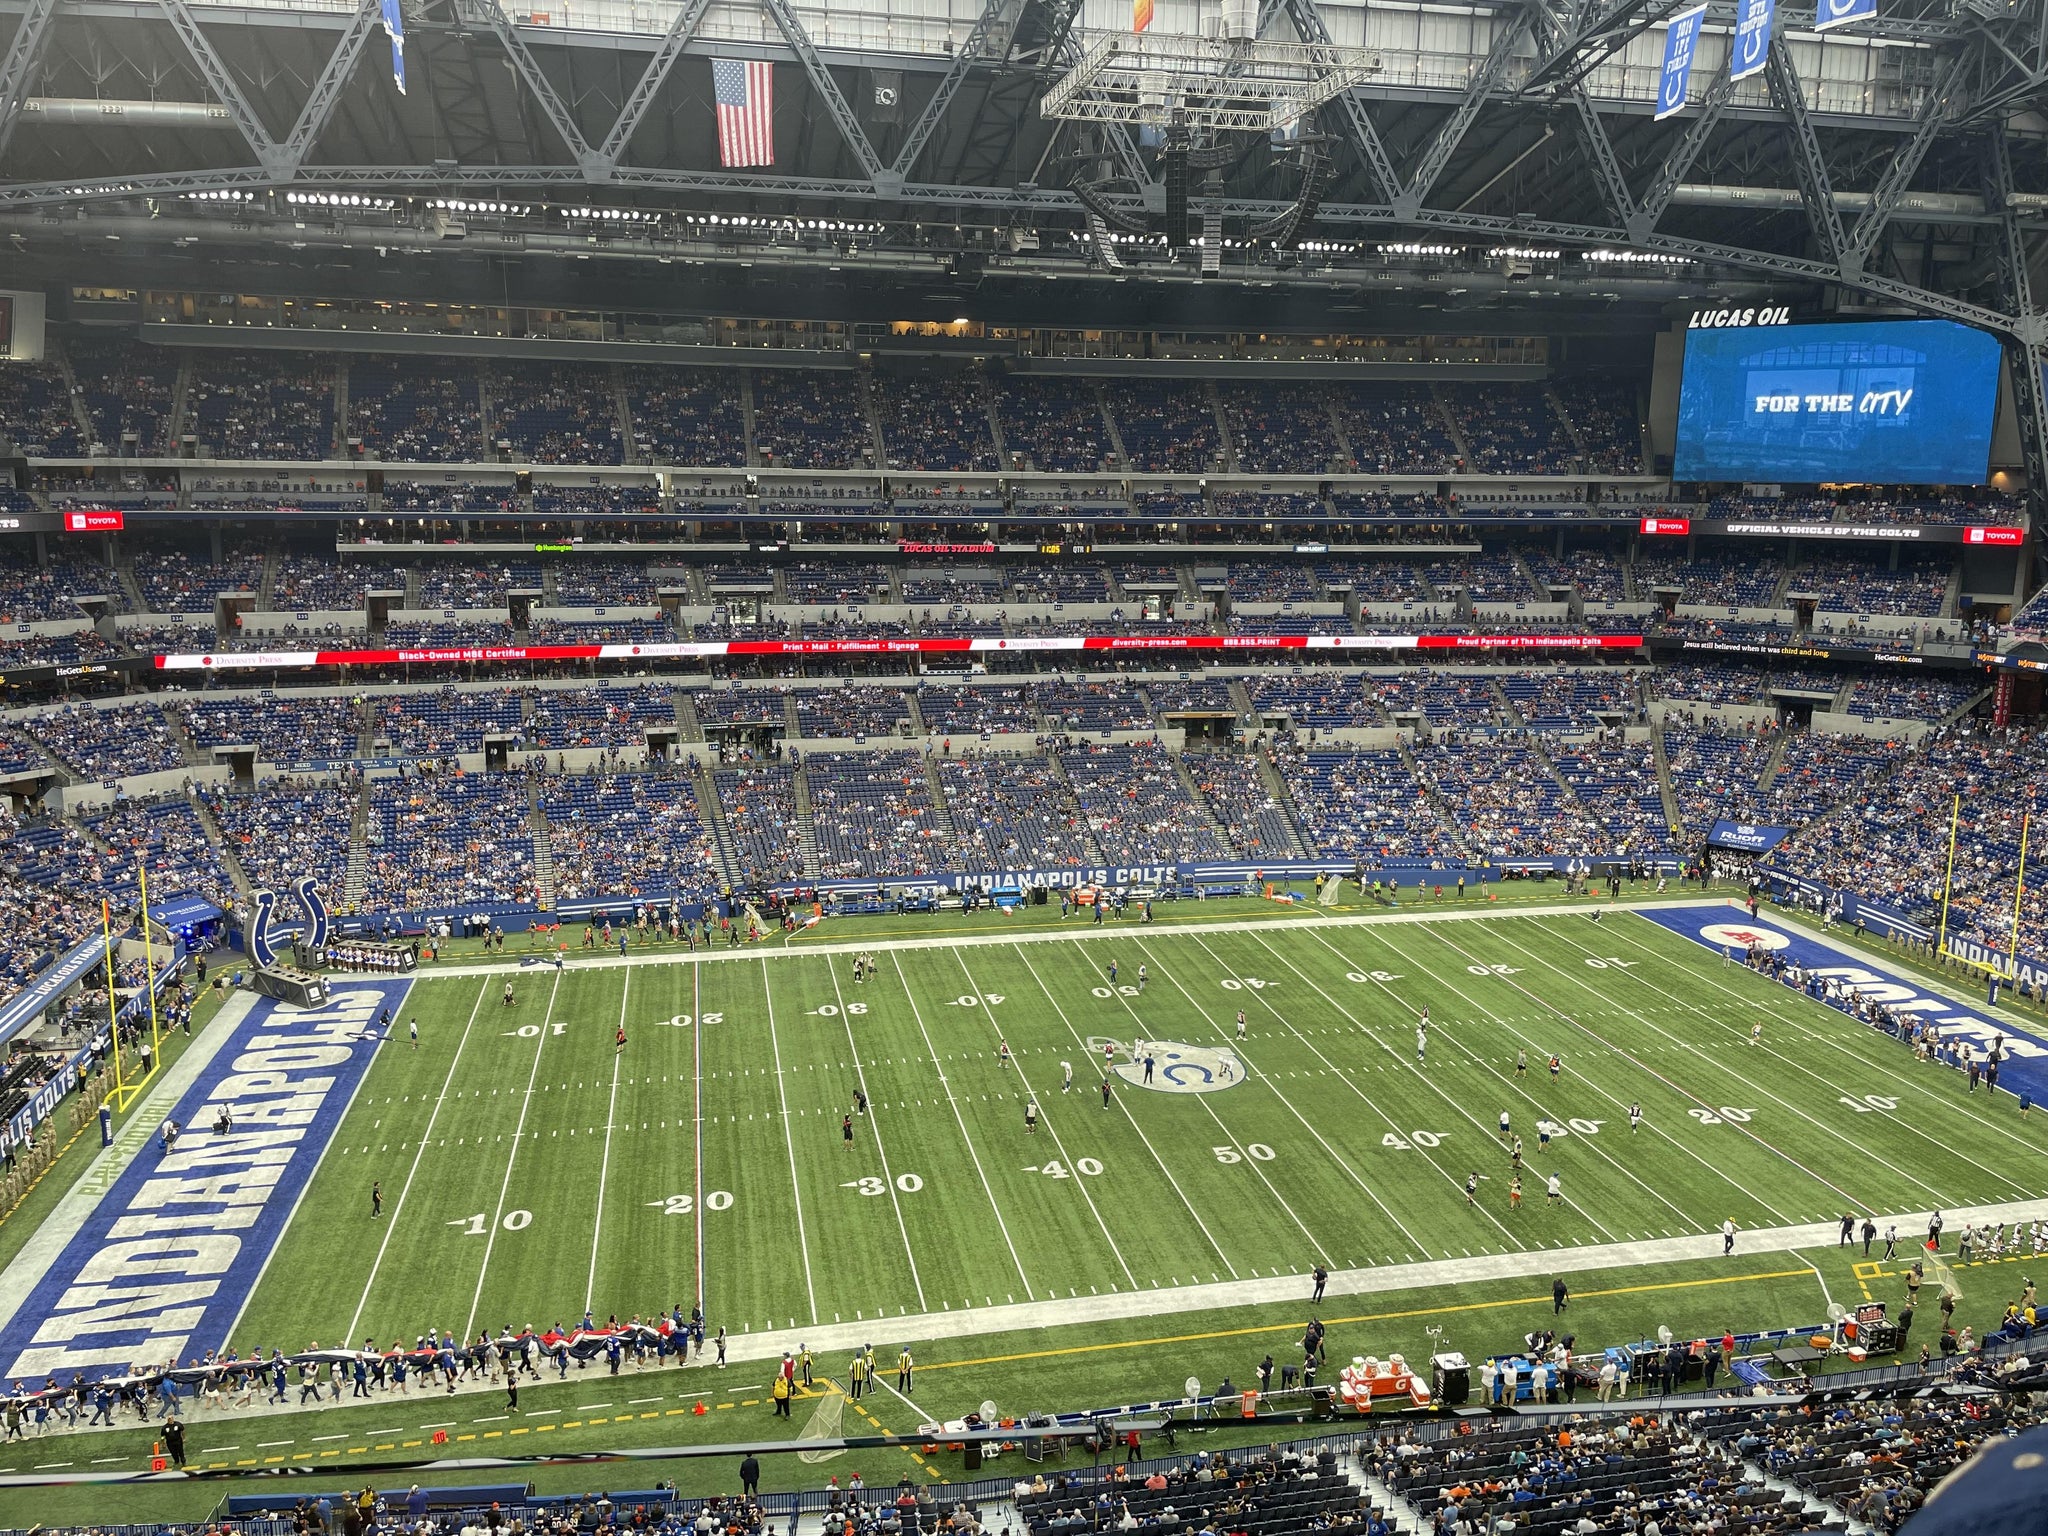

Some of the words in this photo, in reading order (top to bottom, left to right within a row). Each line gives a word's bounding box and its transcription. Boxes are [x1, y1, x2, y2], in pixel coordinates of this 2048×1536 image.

[1676, 17, 1694, 39] 2014
[1688, 309, 1753, 328] LUCAS
[1757, 307, 1790, 326] OIL
[1755, 397, 1799, 413] FOR
[1805, 395, 1854, 412] THE
[1859, 389, 1913, 415] CITY
[87, 517, 117, 525] TOYOTA
[1727, 525, 1780, 534] OFFICIAL
[1782, 526, 1832, 535] VEHICLE
[1835, 527, 1850, 536] OF
[1852, 528, 1876, 536] THE
[1879, 528, 1920, 538] COLTS
[1986, 531, 2016, 540] TOYOTA
[543, 544, 573, 552] Huntington
[904, 545, 933, 553] LUCAS
[935, 545, 950, 553] OIL
[952, 545, 994, 553] STADIUM
[1073, 545, 1084, 553] QTR
[782, 642, 803, 651] Print
[812, 642, 829, 650] Mail
[837, 642, 880, 650] Fulfillment
[888, 641, 920, 651] Signage
[1112, 638, 1187, 647] diversity-press.com
[1457, 637, 1479, 646] Proud
[1481, 637, 1509, 646] Partner
[1511, 637, 1519, 646] of
[1521, 637, 1534, 646] The
[1535, 637, 1580, 647] Indianapolis
[1582, 637, 1602, 646] Colts
[399, 650, 461, 660] Black-Owned
[463, 650, 483, 659] MBE
[485, 649, 526, 659] Certified
[1683, 640, 1700, 650] Jesus
[1701, 641, 1713, 650] still
[1714, 642, 1741, 651] believed
[1781, 647, 1798, 655] third
[1799, 648, 1812, 656] and
[1813, 649, 1829, 659] long.
[216, 656, 256, 665] DIVERSITY
[258, 655, 283, 664] PRESS
[1874, 653, 1922, 664] HeGetsUs.com
[56, 664, 107, 677] HeGetsUs.com
[1718, 837, 1763, 848] MORTGAGE
[1720, 831, 1766, 844] Ruoff
[956, 868, 1107, 891] INDIANAPOLIS
[1115, 866, 1176, 884] COLTS
[34, 974, 66, 996] LUCAS
[59, 961, 79, 980] OIL
[70, 937, 106, 970] STADIUM
[1584, 956, 1632, 970] 10
[1345, 970, 1396, 984] 30
[1467, 964, 1516, 977] 20
[1221, 977, 1267, 991] 40
[1091, 985, 1141, 998] 50
[957, 993, 1006, 1007] 40
[818, 1002, 868, 1017] 30
[670, 1012, 723, 1027] 20
[517, 1023, 568, 1037] 10
[36, 1064, 76, 1121] COLTS
[1839, 1094, 1897, 1113] 10
[1687, 1106, 1752, 1125] 20
[77, 1160, 126, 1196] PLAY
[110, 1095, 180, 1155] FOOTBALL
[1381, 1129, 1441, 1150] 40
[1215, 1142, 1276, 1164] 50
[1041, 1157, 1104, 1180] 40
[5, 990, 385, 1380] INDIANAPOLIS
[857, 1173, 924, 1196] 30
[664, 1190, 734, 1215] 20
[464, 1209, 533, 1235] 10
[1395, 1378, 1406, 1390] G
[435, 1430, 446, 1443] 10
[155, 1460, 162, 1471] G
